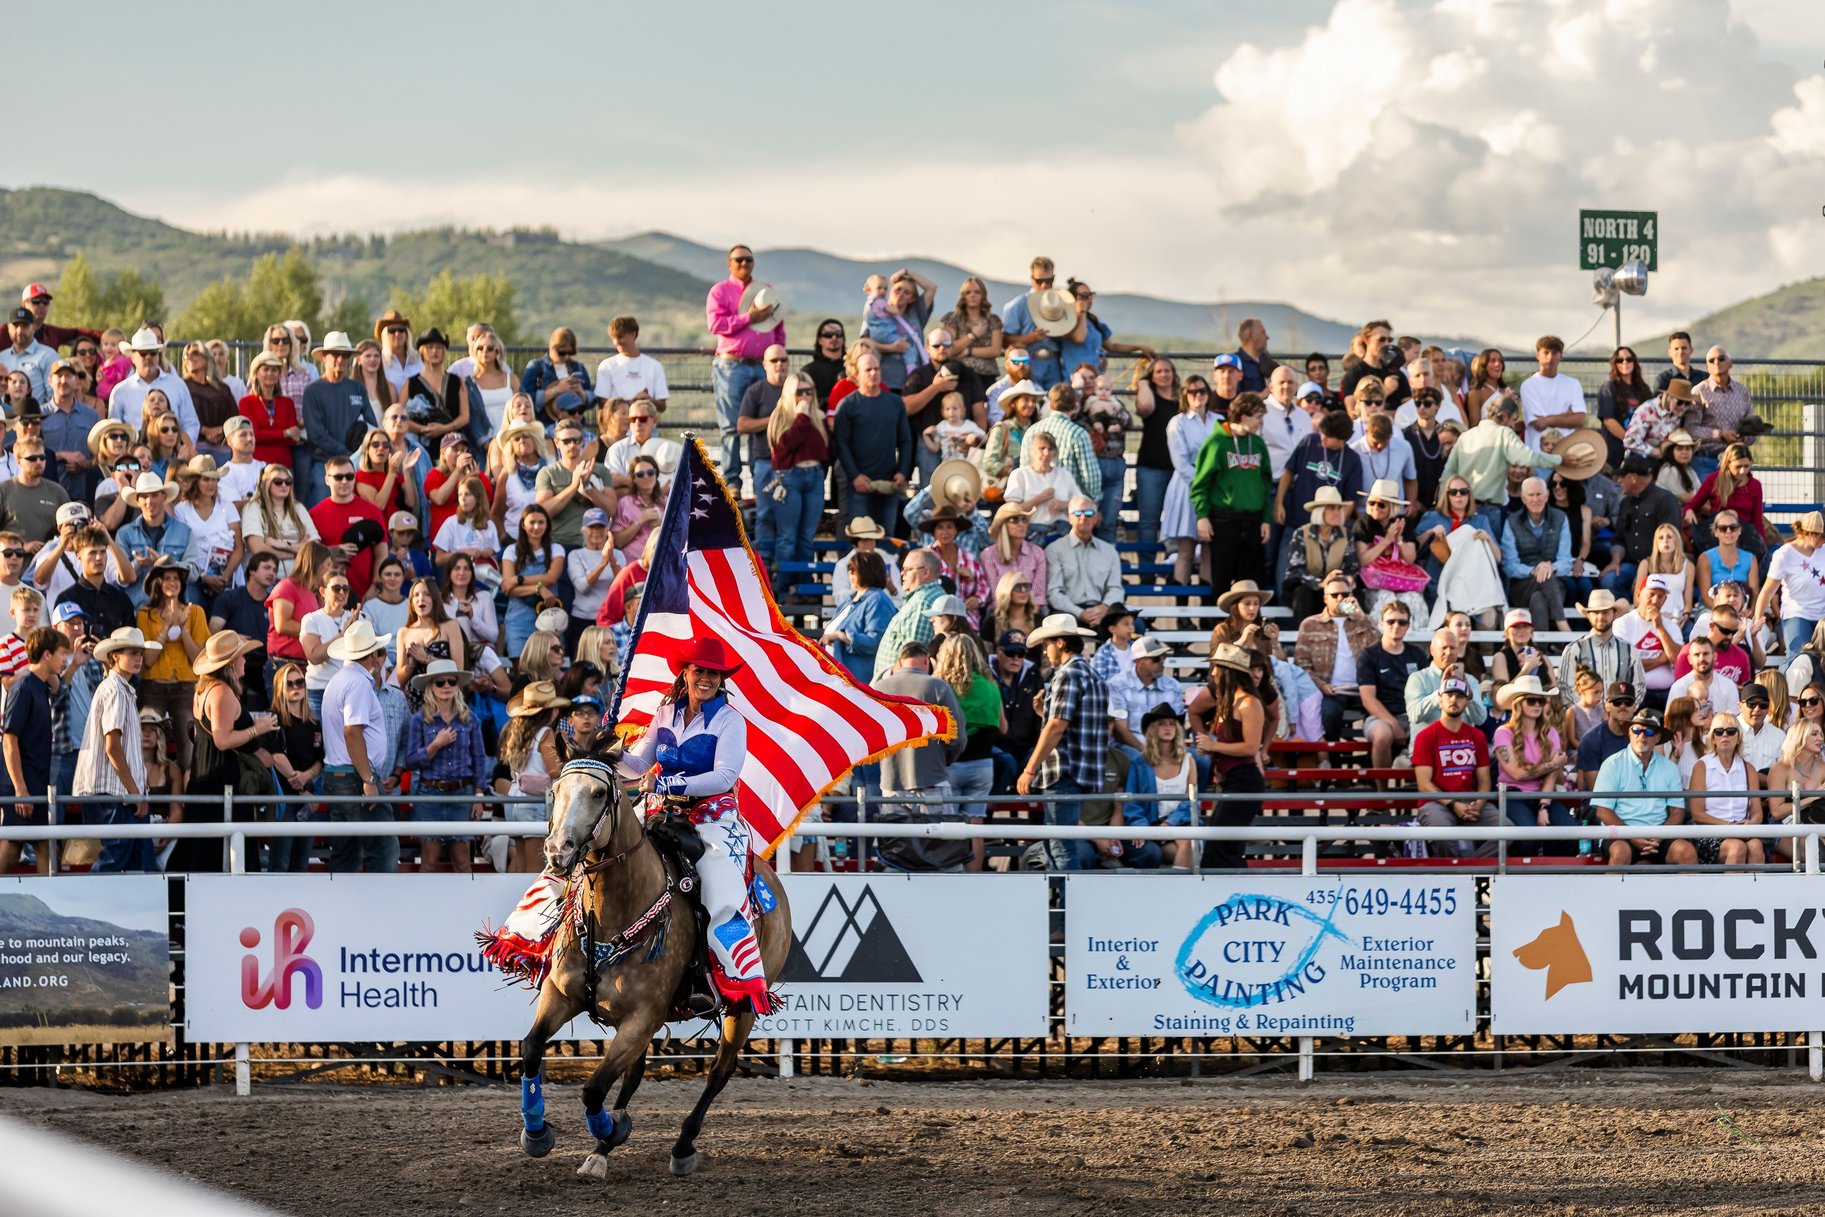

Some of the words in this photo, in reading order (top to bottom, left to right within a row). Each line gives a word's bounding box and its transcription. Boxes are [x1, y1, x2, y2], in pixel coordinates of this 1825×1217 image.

[1583, 217, 1638, 239] NORTH
[1643, 219, 1654, 239] 4
[1587, 243, 1605, 264] 91
[1622, 244, 1651, 265] 120
[1439, 748, 1477, 767] FOX
[1214, 897, 1294, 927] PARK
[9, 938, 22, 948] to
[26, 936, 85, 948] mountain
[89, 934, 130, 949] peaks,
[1087, 936, 1159, 952] Interior
[1362, 936, 1435, 952] Exterior
[1618, 908, 1825, 961] ROCK
[1, 952, 32, 964] hood
[36, 952, 59, 964] and
[63, 953, 84, 963] our
[88, 951, 131, 965] legacy.
[1223, 940, 1286, 963] CITY
[1116, 954, 1131, 971] &
[1340, 954, 1457, 970] Maintenance
[0, 975, 69, 988] AND.ORG
[1086, 973, 1160, 990] Exterior
[1184, 959, 1326, 1006] PAINTING
[1359, 973, 1437, 993] Program
[1619, 973, 1806, 1000] MOUNTAIN
[340, 981, 437, 1008] Health
[840, 993, 963, 1012] DENTISTRY
[911, 1018, 949, 1032] DDS
[1153, 1013, 1231, 1034] Staining
[1235, 1013, 1250, 1030] &
[1255, 1013, 1355, 1033] Repainting
